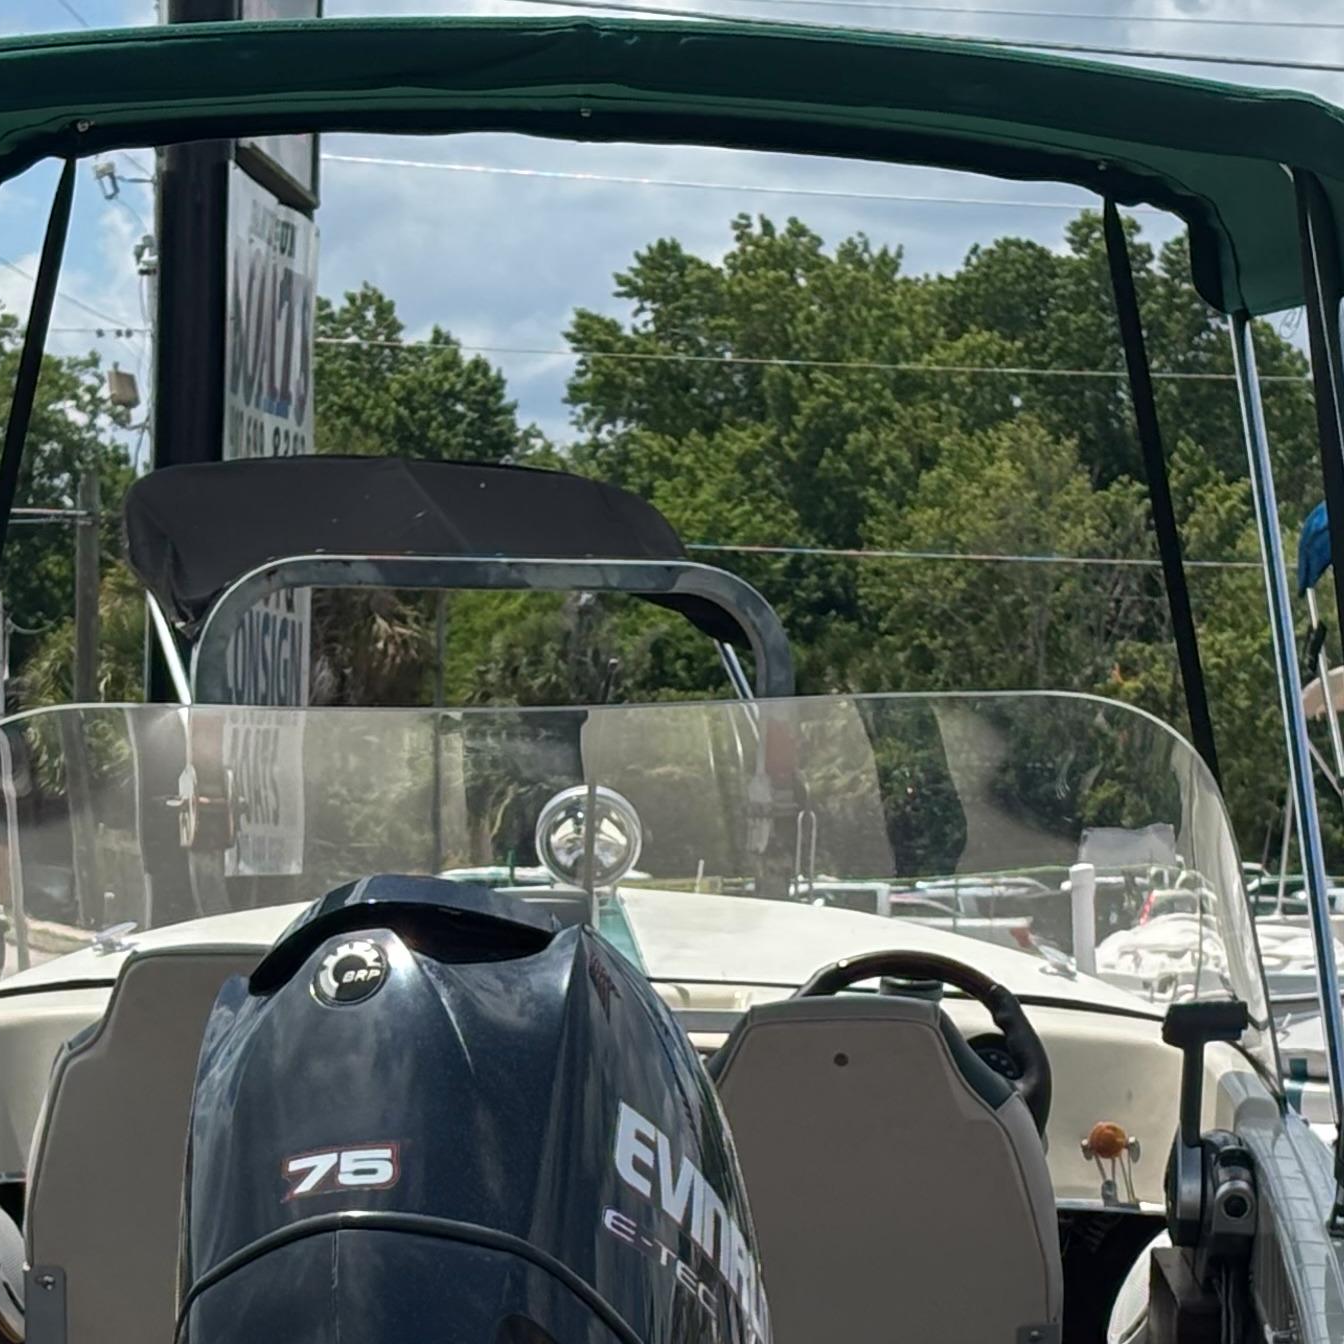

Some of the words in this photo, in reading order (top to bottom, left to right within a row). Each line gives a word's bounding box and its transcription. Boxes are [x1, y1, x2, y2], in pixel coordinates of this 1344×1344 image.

[342, 968, 381, 984] BRP
[288, 1148, 393, 1194] 75
[602, 1206, 718, 1320] E-TEC
